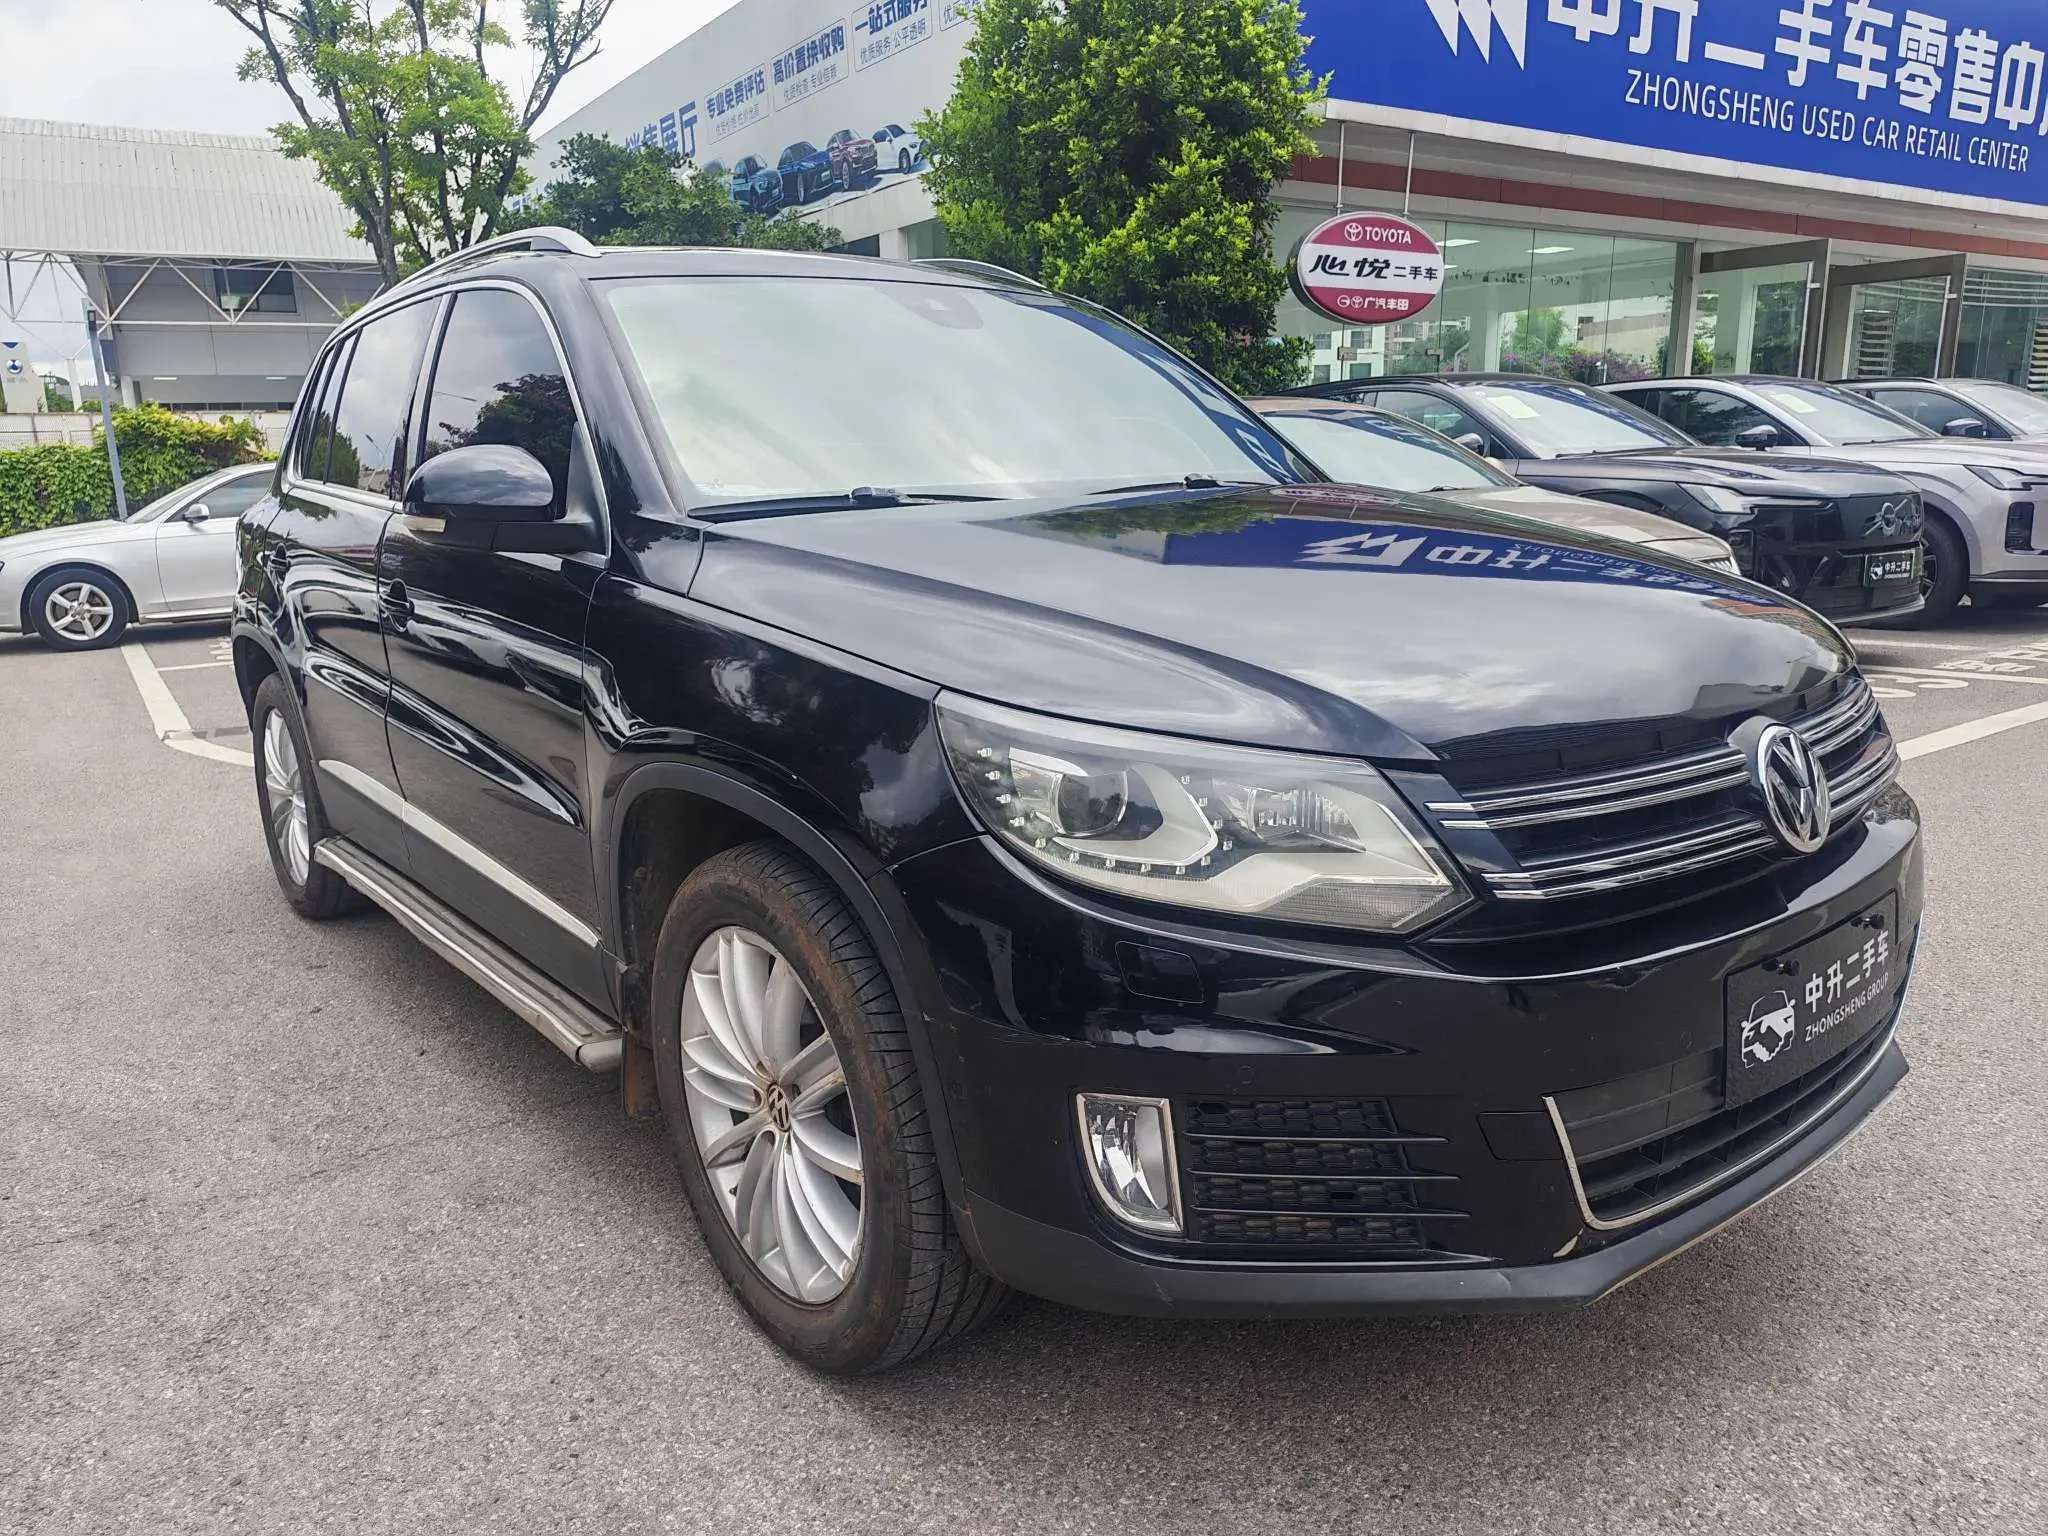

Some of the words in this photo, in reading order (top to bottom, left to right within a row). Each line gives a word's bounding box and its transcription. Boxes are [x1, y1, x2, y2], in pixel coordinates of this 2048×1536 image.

[773, 25, 844, 85] 高价置换收购
[1548, 0, 2048, 136] 升手车零售中
[1625, 68, 1795, 132] ZHONGSHENG
[1802, 103, 1856, 142] USED
[1862, 116, 1900, 151] CAR
[1905, 124, 1962, 162] RETAIL
[1968, 136, 2029, 172] CENTER
[1365, 226, 1412, 245] TOYOTA
[1363, 297, 1410, 311] 广汽丰田
[1805, 930, 1889, 1013] 中升二手车
[1805, 990, 1867, 1042] ZHONGSHENG
[1867, 972, 1889, 1001] GROUP
